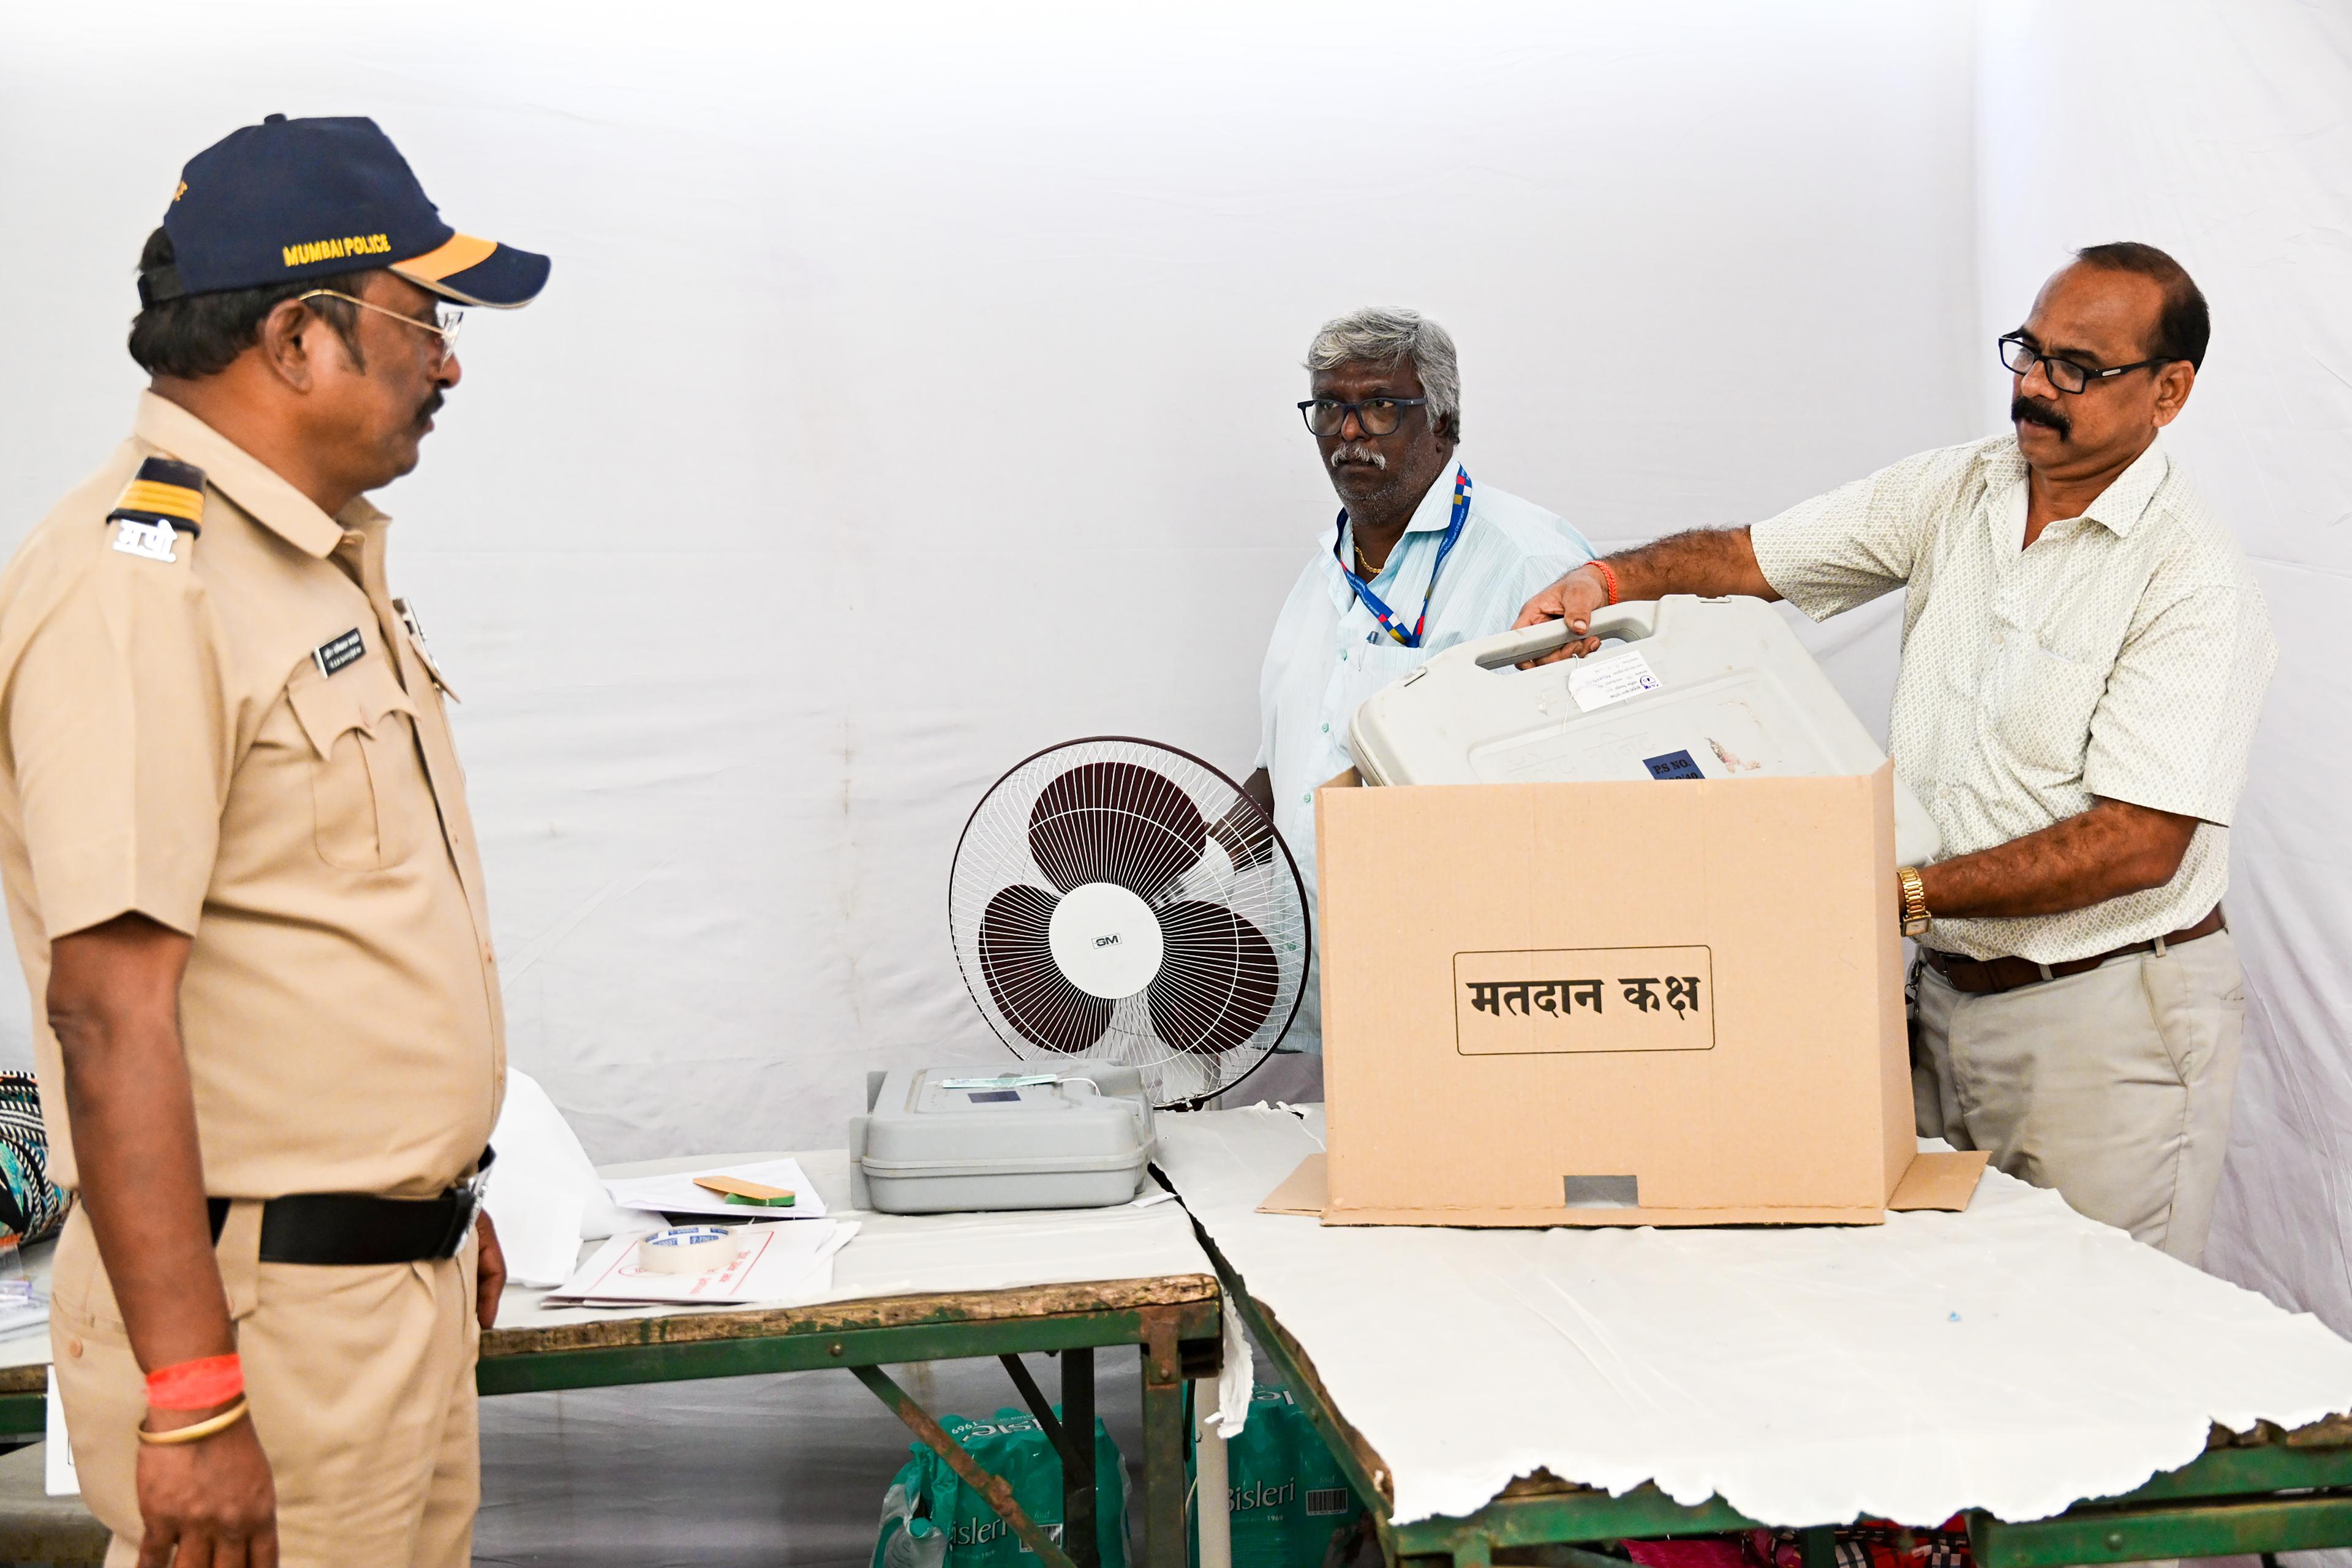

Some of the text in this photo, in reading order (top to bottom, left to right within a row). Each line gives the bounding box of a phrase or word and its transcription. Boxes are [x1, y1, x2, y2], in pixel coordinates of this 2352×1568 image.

[282, 233, 392, 268] MUMBAI POLICE
[1653, 759, 1692, 775] P.S NO.
[1465, 976, 1701, 1020] मतदान कक्ष
[951, 1421, 978, 1435] 1969
[949, 1516, 1008, 1552] isleri
